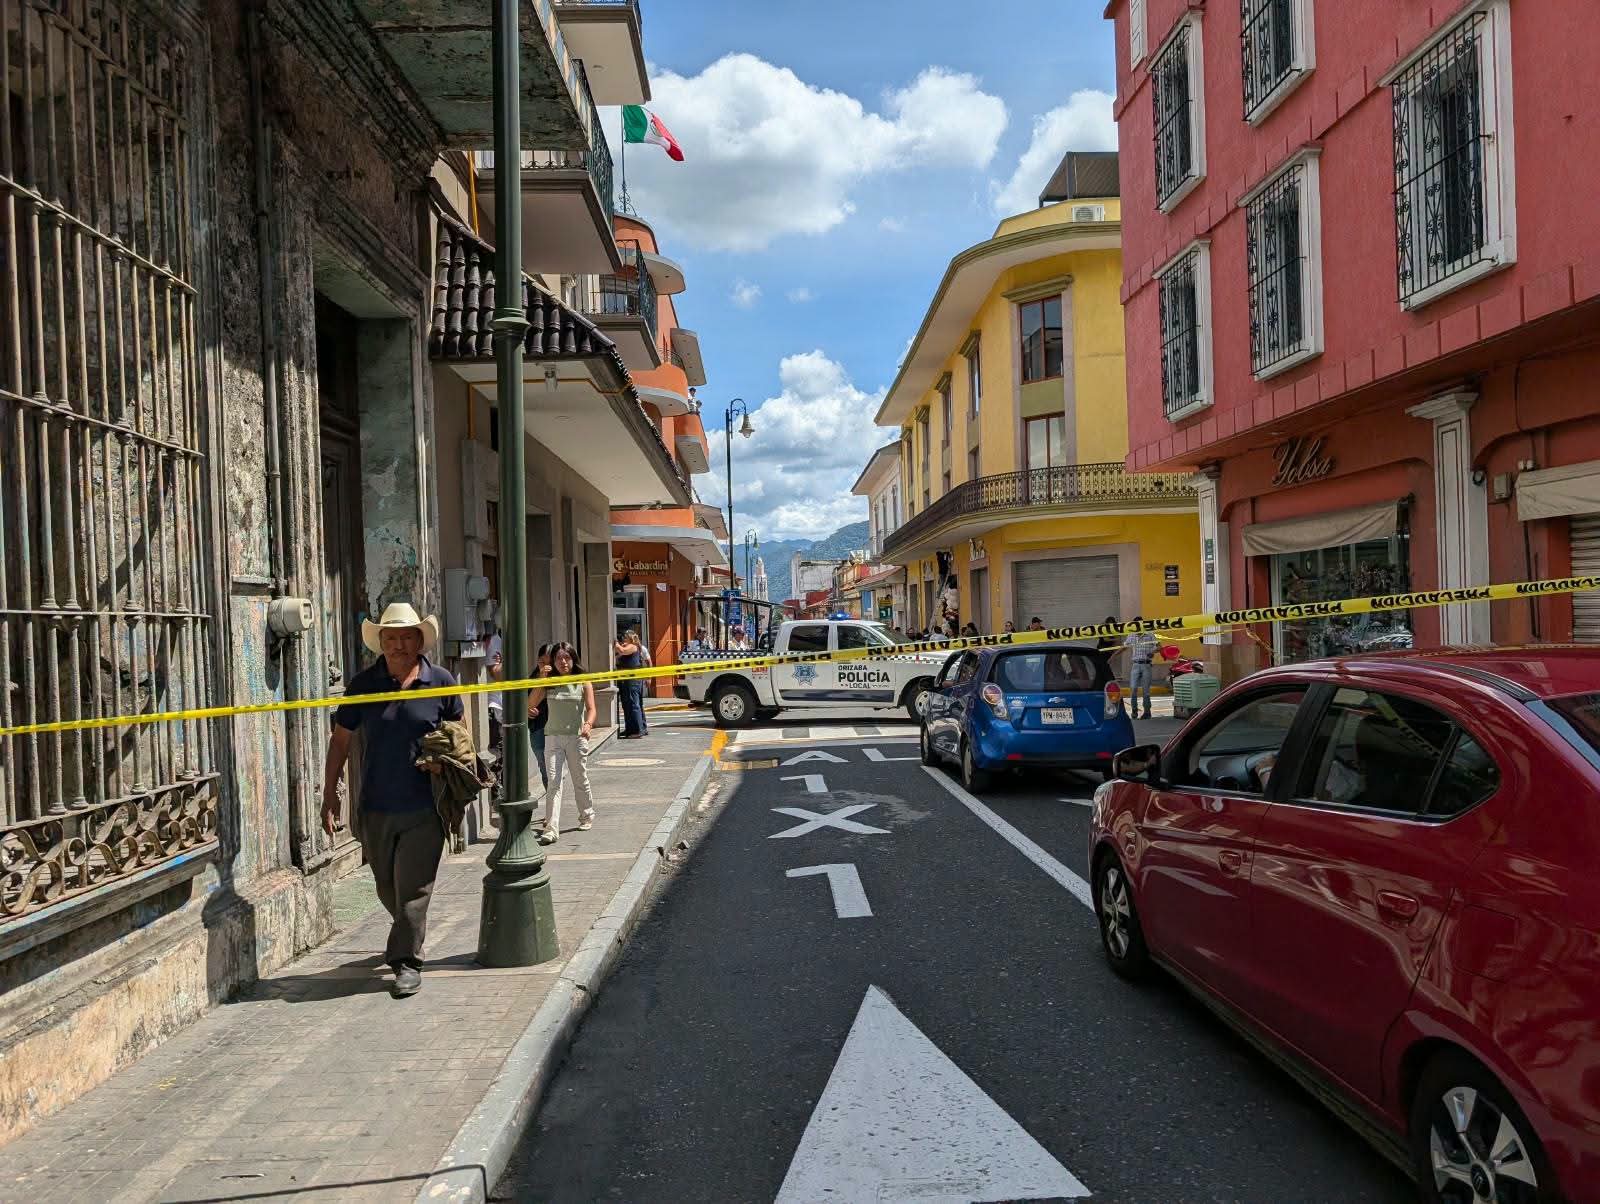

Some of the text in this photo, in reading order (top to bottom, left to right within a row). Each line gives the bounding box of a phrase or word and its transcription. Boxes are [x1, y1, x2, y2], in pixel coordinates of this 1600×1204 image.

[1371, 586, 1491, 610] PRECAUCION
[1215, 601, 1344, 625] PRECAUCION
[1047, 616, 1184, 641] PRECAUCION
[838, 669, 891, 682] POLICÍA
